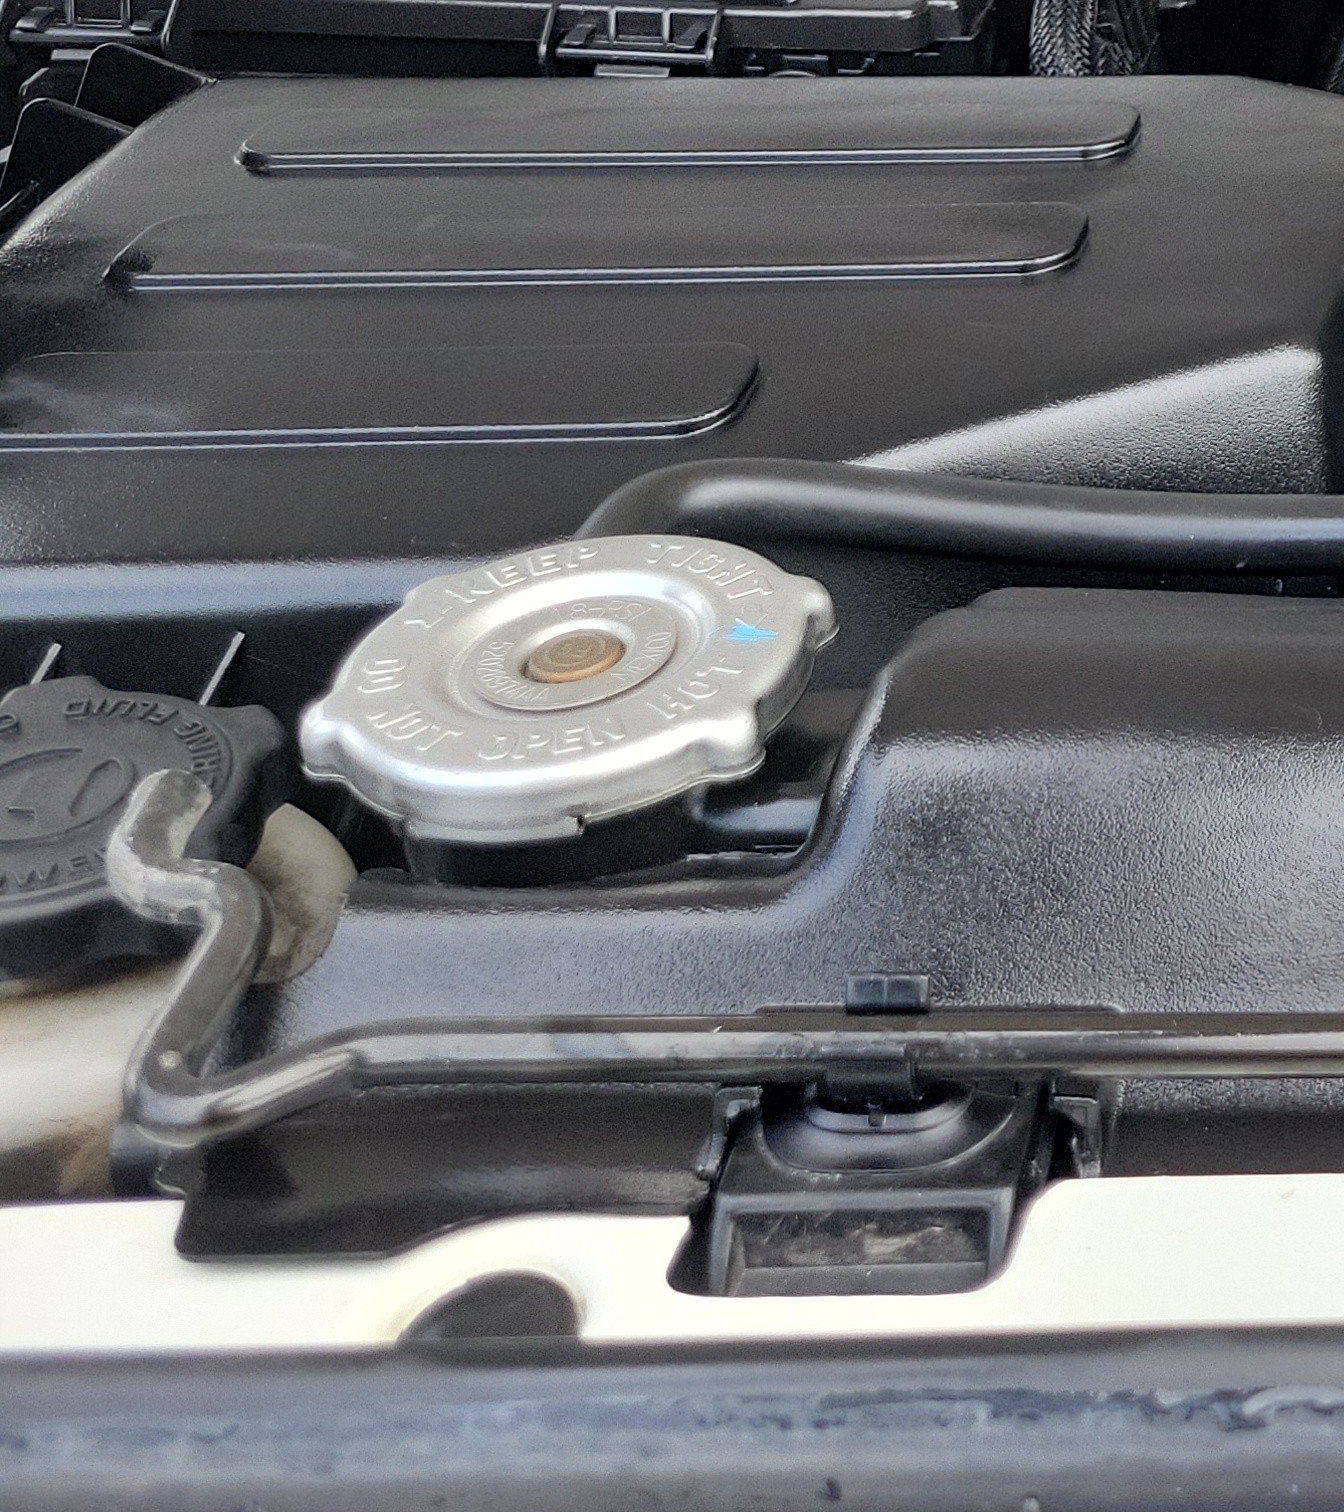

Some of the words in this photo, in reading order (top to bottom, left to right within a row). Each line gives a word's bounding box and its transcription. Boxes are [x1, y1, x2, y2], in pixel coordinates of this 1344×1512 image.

[647, 543, 774, 600] TIGHT
[609, 630, 673, 682] MEXICO
[63, 697, 180, 727] FLUID
[366, 704, 466, 753] NOT
[477, 717, 627, 763] OPEN
[646, 662, 746, 721] HOT
